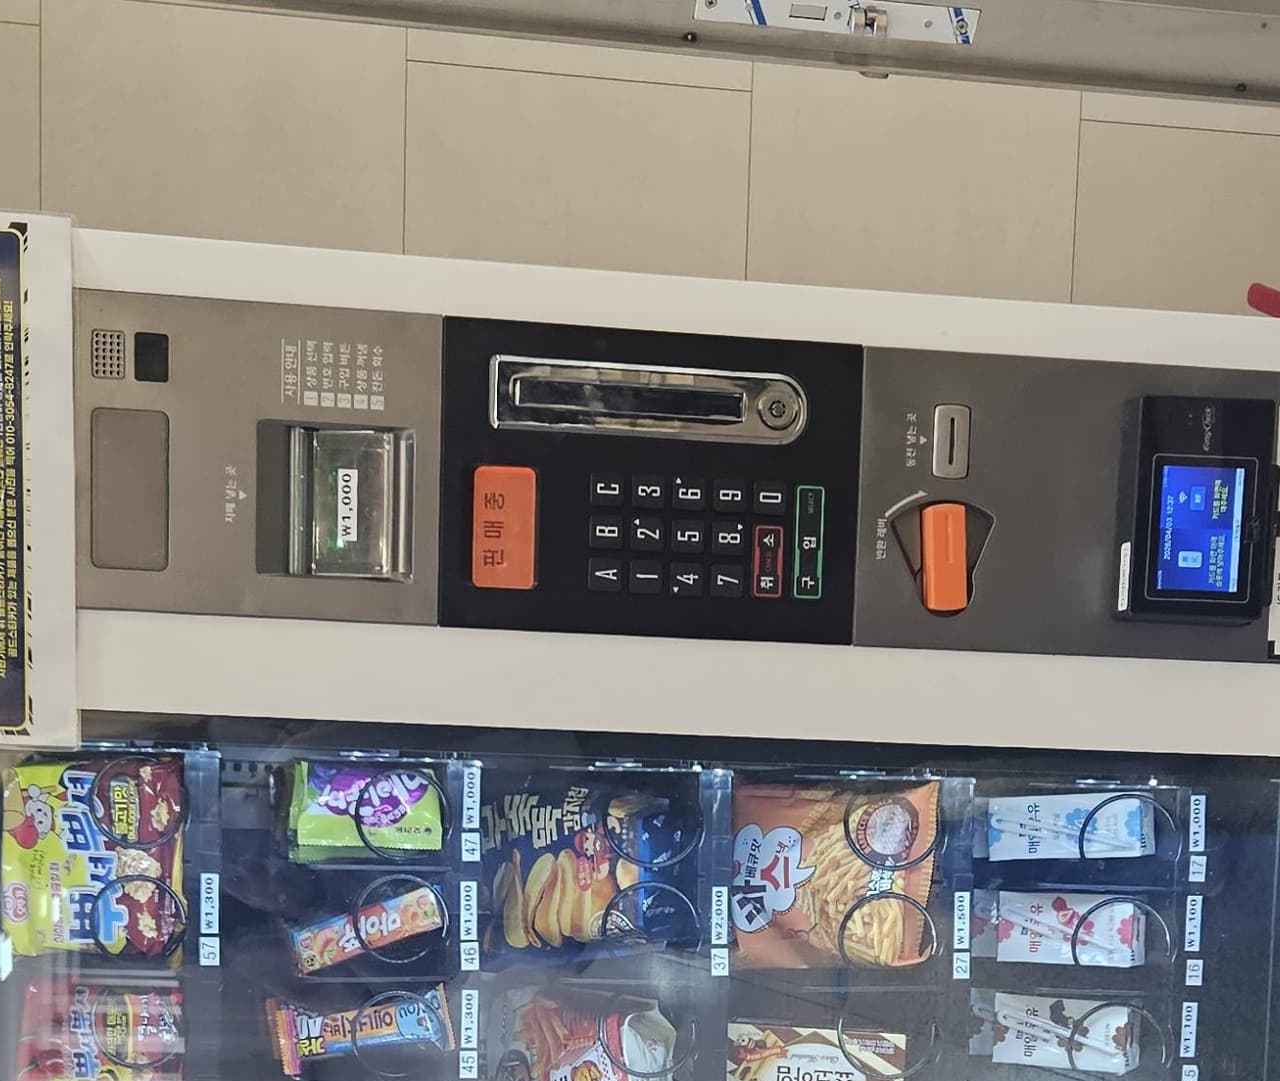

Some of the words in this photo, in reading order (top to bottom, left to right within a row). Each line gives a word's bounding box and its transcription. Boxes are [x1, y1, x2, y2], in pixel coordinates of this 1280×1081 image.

[4, 300, 14, 351] 연락주세요!
[285, 345, 297, 370] 안내
[306, 340, 318, 362] 선택
[286, 372, 297, 397] 사용
[306, 366, 318, 388] 상품
[4, 354, 16, 444] 010-3054-8247로
[226, 465, 236, 476] 곳
[225, 479, 236, 500] 넣는
[597, 483, 619, 494] C
[638, 486, 660, 497] 3
[679, 488, 701, 500] 6
[720, 490, 741, 501] 9
[760, 492, 782, 503] 0
[596, 526, 618, 536] B
[638, 528, 660, 540] 2
[678, 530, 700, 542] 5
[718, 532, 740, 544] 8
[594, 569, 618, 580] A
[677, 574, 699, 584] 4
[718, 574, 740, 586] 7
[110, 784, 130, 837] 불고기맛
[562, 786, 589, 832] 감자칩
[59, 771, 128, 944] 뿌셔뿌셔
[744, 838, 762, 879] 베큐맛
[338, 912, 402, 953] 마이쮸
[202, 942, 216, 962] 57
[463, 946, 478, 965] 46
[68, 986, 98, 1080] 뿌셔뿌셔
